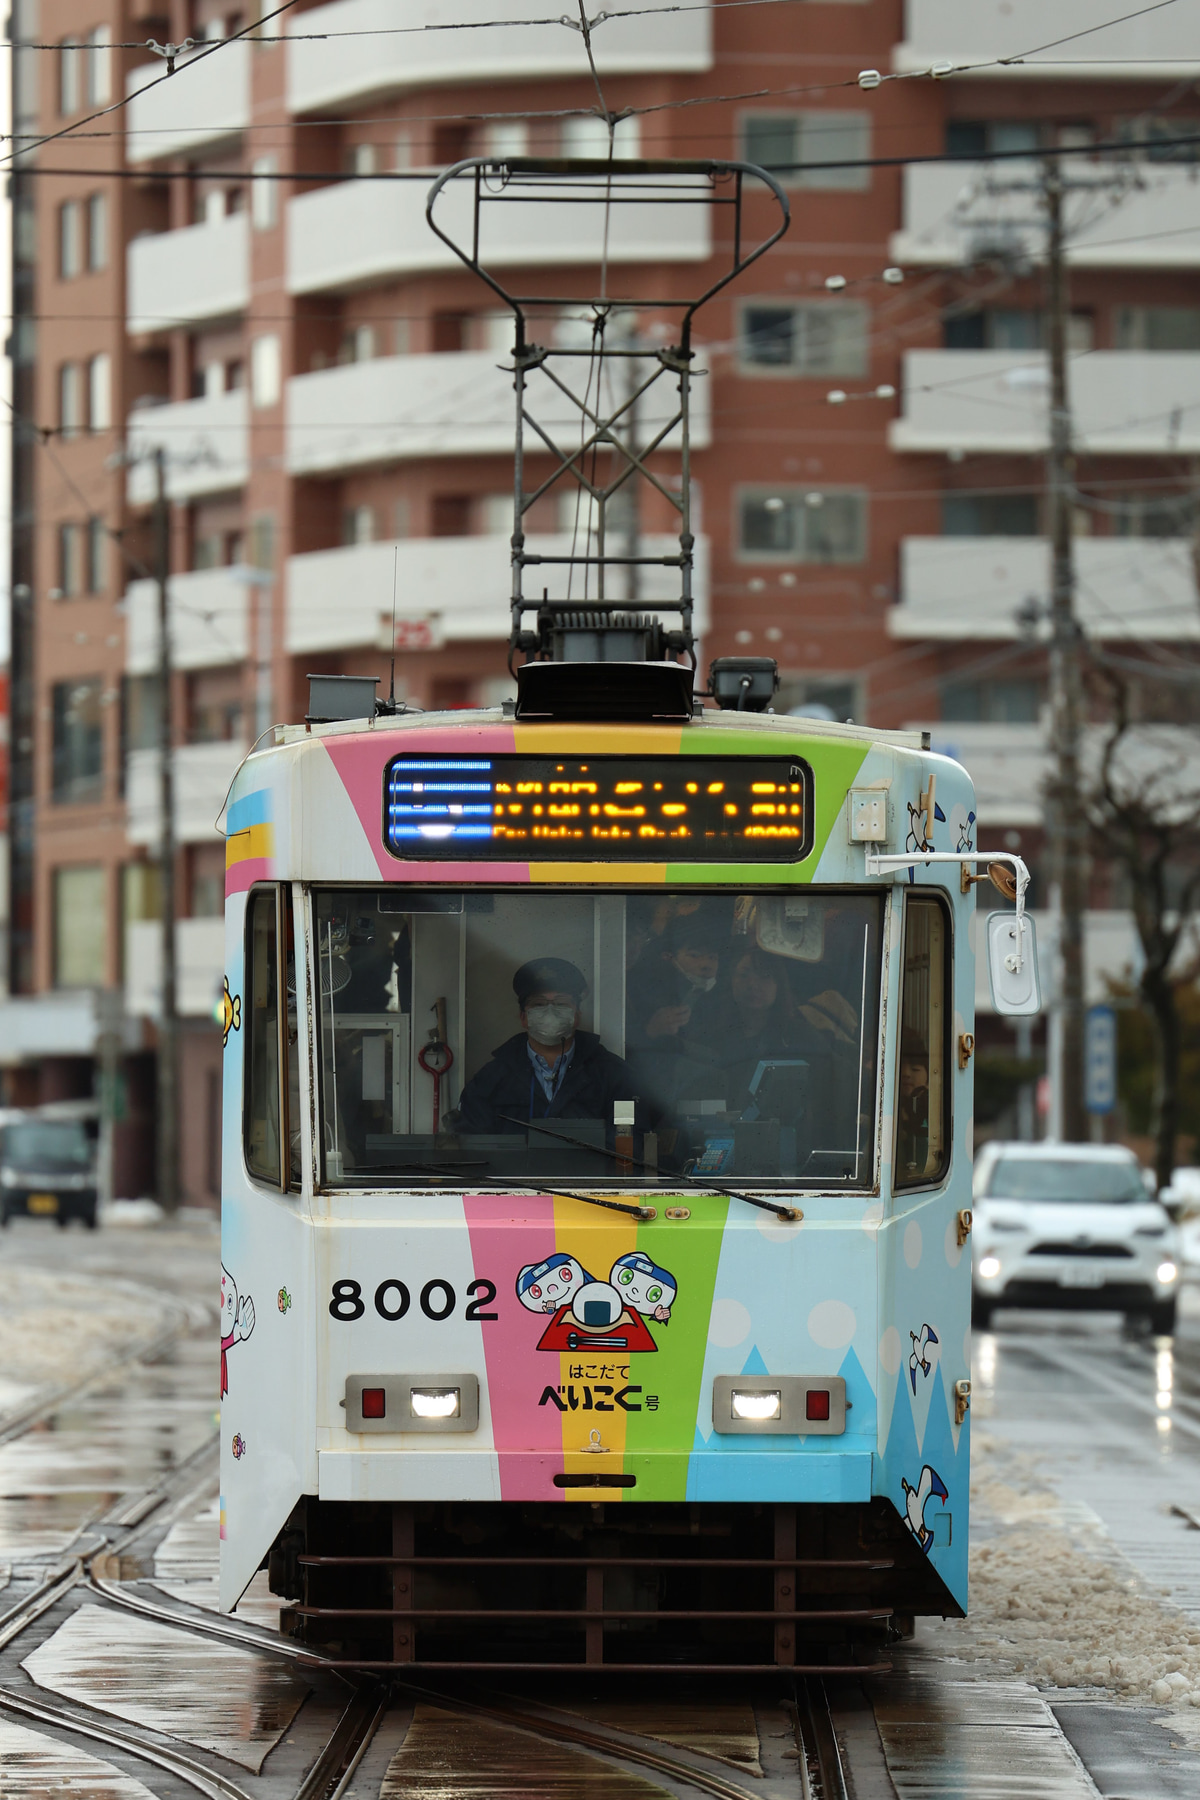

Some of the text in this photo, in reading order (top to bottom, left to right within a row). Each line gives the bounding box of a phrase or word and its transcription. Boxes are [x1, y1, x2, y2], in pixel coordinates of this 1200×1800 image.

[329, 1279, 498, 1321] 8002
[569, 1364, 630, 1379] はこだて
